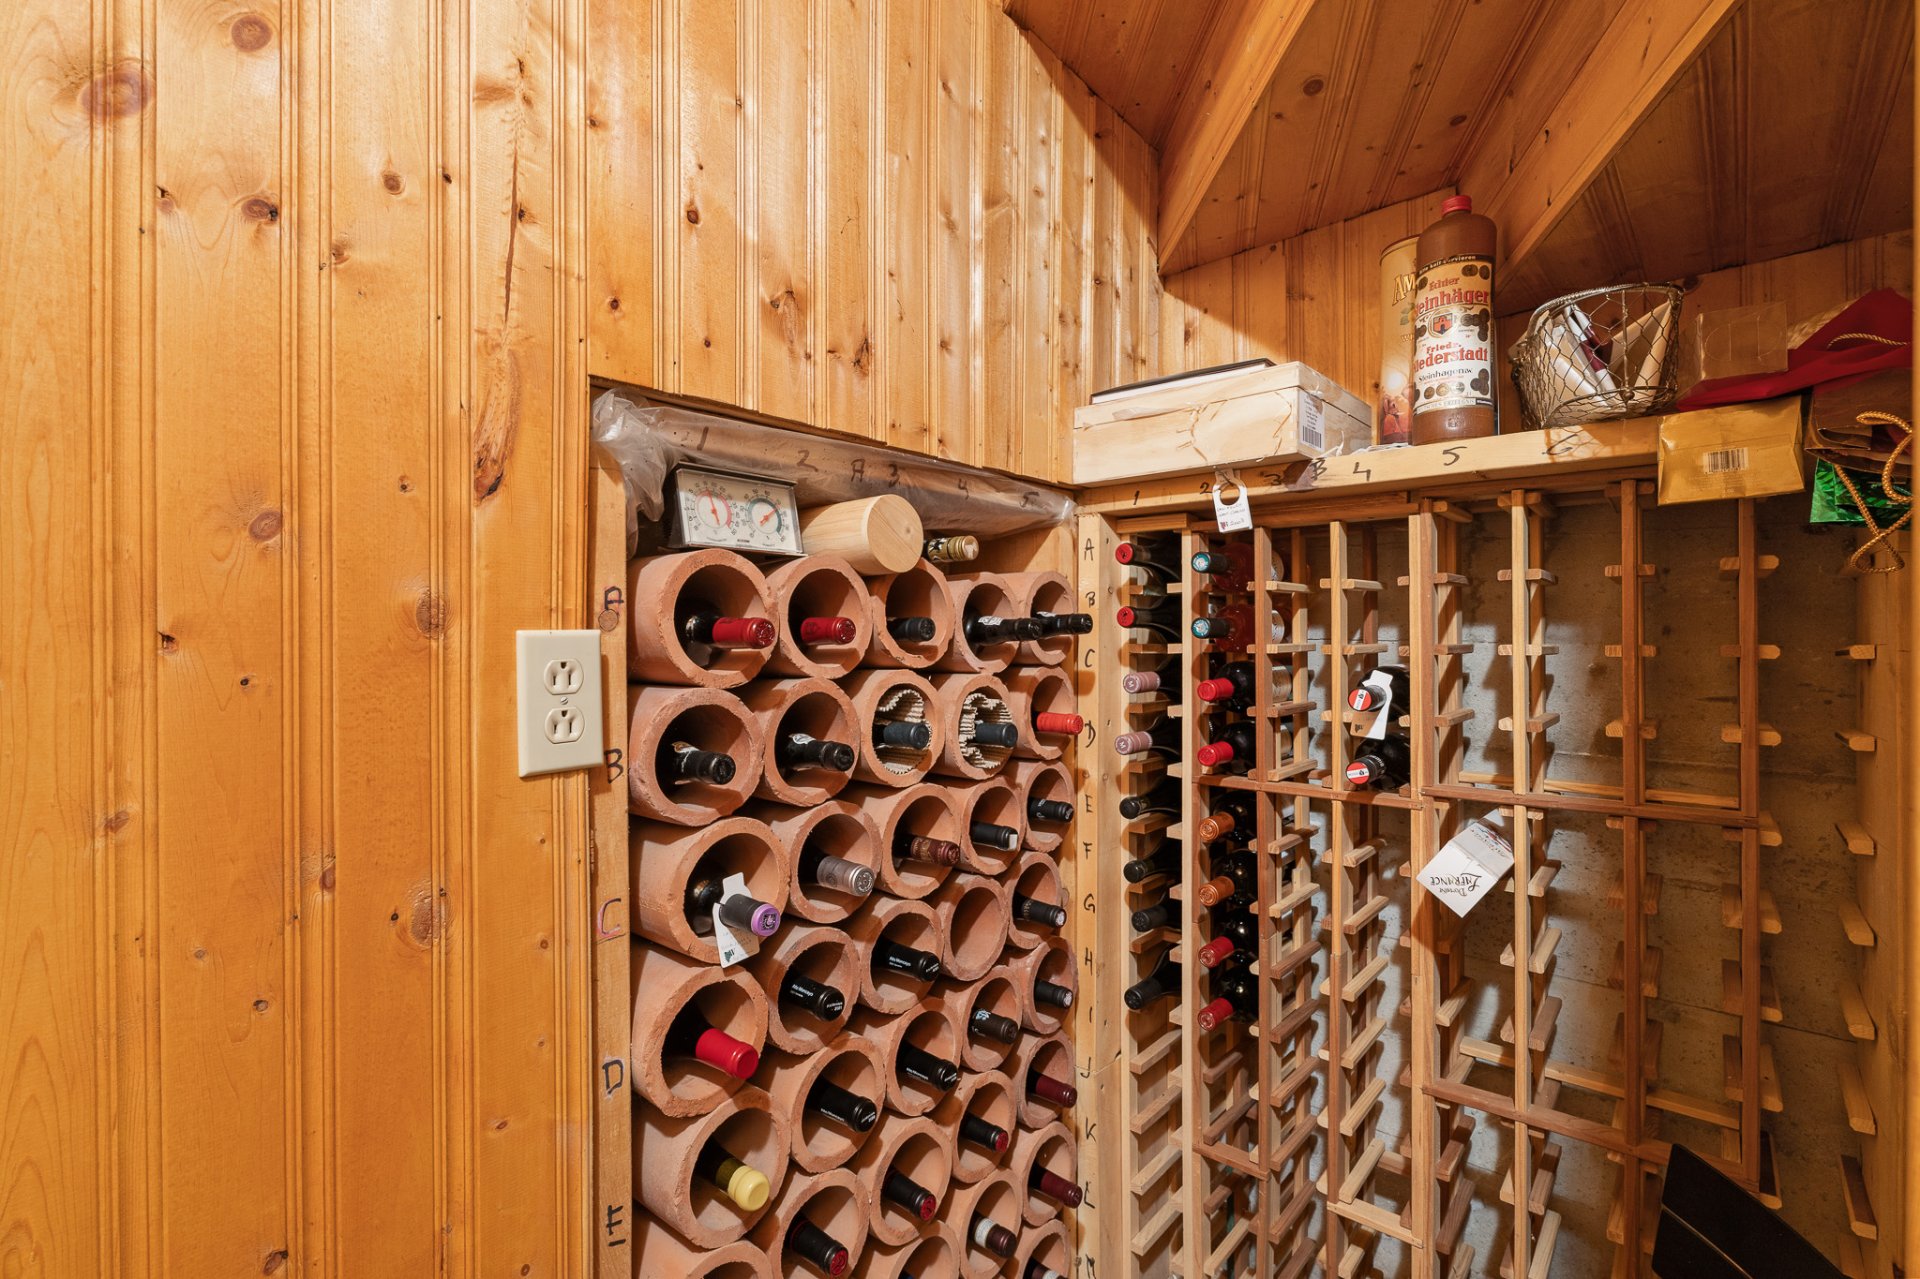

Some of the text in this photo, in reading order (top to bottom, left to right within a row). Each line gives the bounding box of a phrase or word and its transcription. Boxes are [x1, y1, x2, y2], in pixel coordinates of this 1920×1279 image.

[1391, 272, 1416, 307] AM
[1415, 288, 1489, 316] einhäger
[797, 450, 818, 472] 2
[850, 458, 866, 482] A
[888, 464, 901, 488] 3
[958, 478, 970, 500] 4
[1132, 490, 1140, 506] 1
[1199, 482, 1214, 495] 2
[1263, 473, 1283, 486] 3
[1353, 461, 1371, 482] 4
[1442, 446, 1467, 466] 5
[1084, 538, 1094, 561] A
[1085, 591, 1097, 608] B
[1084, 648, 1095, 668] C
[1084, 719, 1096, 748] D
[604, 748, 624, 784] B
[1085, 794, 1094, 813] E
[1083, 842, 1093, 859] F
[600, 898, 621, 937] C
[1083, 893, 1095, 914] G
[1085, 947, 1094, 976] H
[602, 1059, 624, 1094] D
[1080, 1057, 1092, 1079] J
[1085, 1117, 1097, 1142] K
